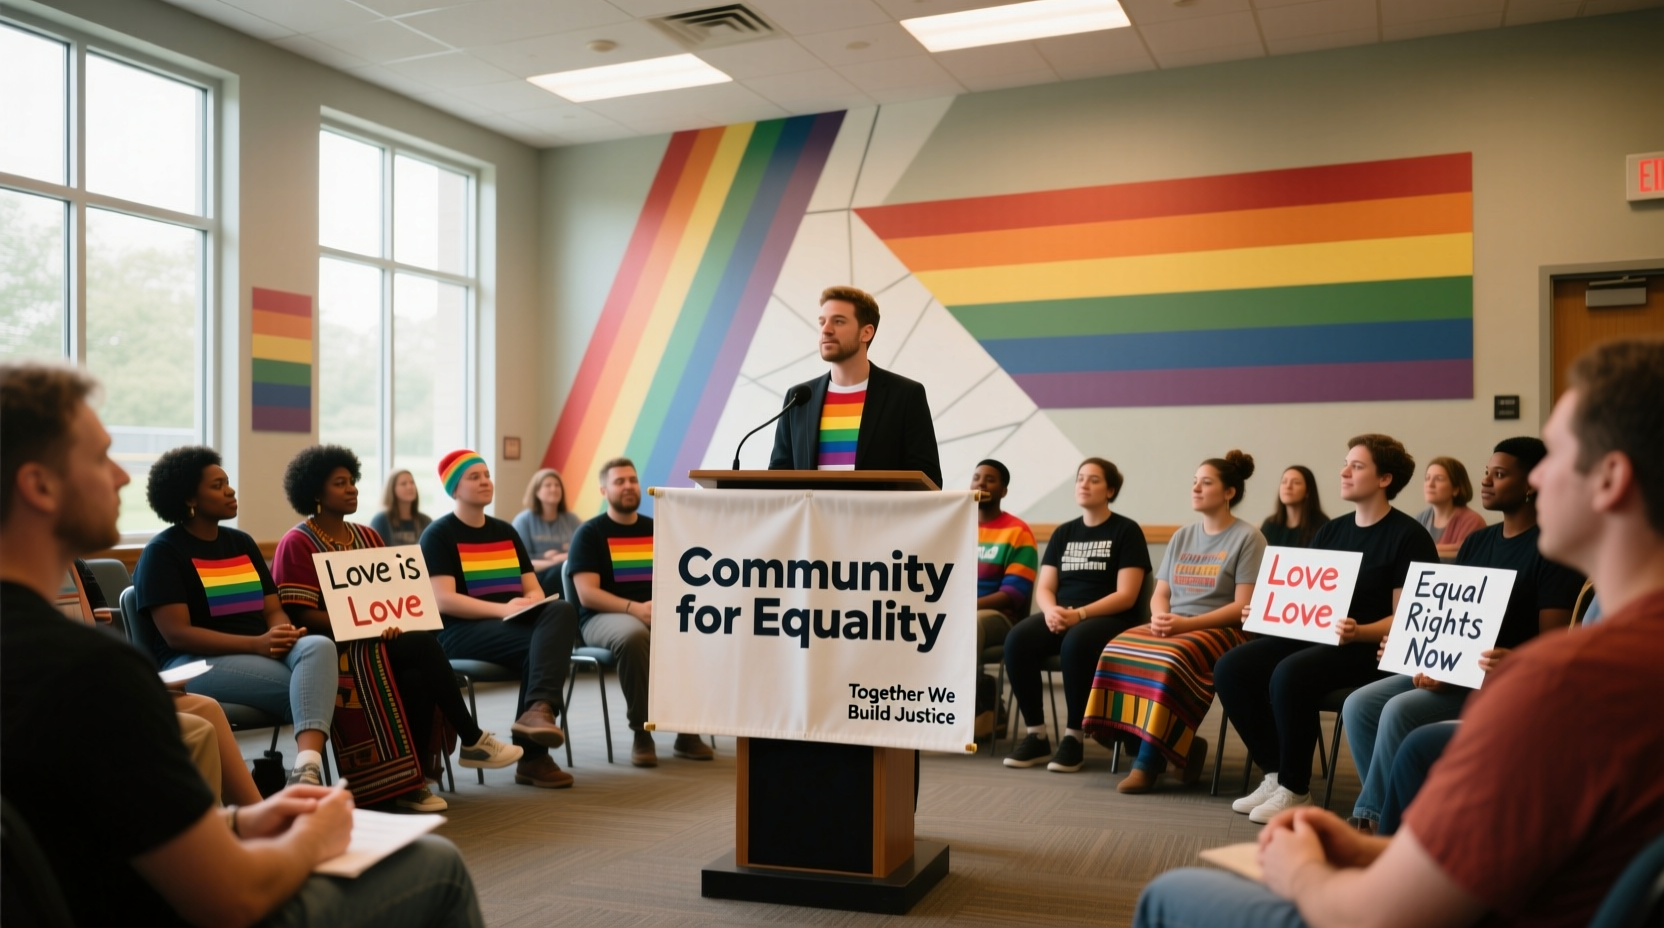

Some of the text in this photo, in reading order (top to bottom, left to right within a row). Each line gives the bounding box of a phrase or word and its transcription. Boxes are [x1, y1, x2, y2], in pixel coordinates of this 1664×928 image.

[325, 553, 421, 590] Love is
[678, 547, 955, 603] Community
[1268, 554, 1338, 591] Love
[1415, 570, 1488, 610] Equal
[347, 595, 424, 626] Love
[676, 594, 947, 653] for Equality
[1263, 592, 1333, 628] Love
[1405, 602, 1483, 643] Rights
[1404, 637, 1462, 671] Now
[849, 683, 956, 704] Together We
[848, 704, 956, 724] Build Justice
